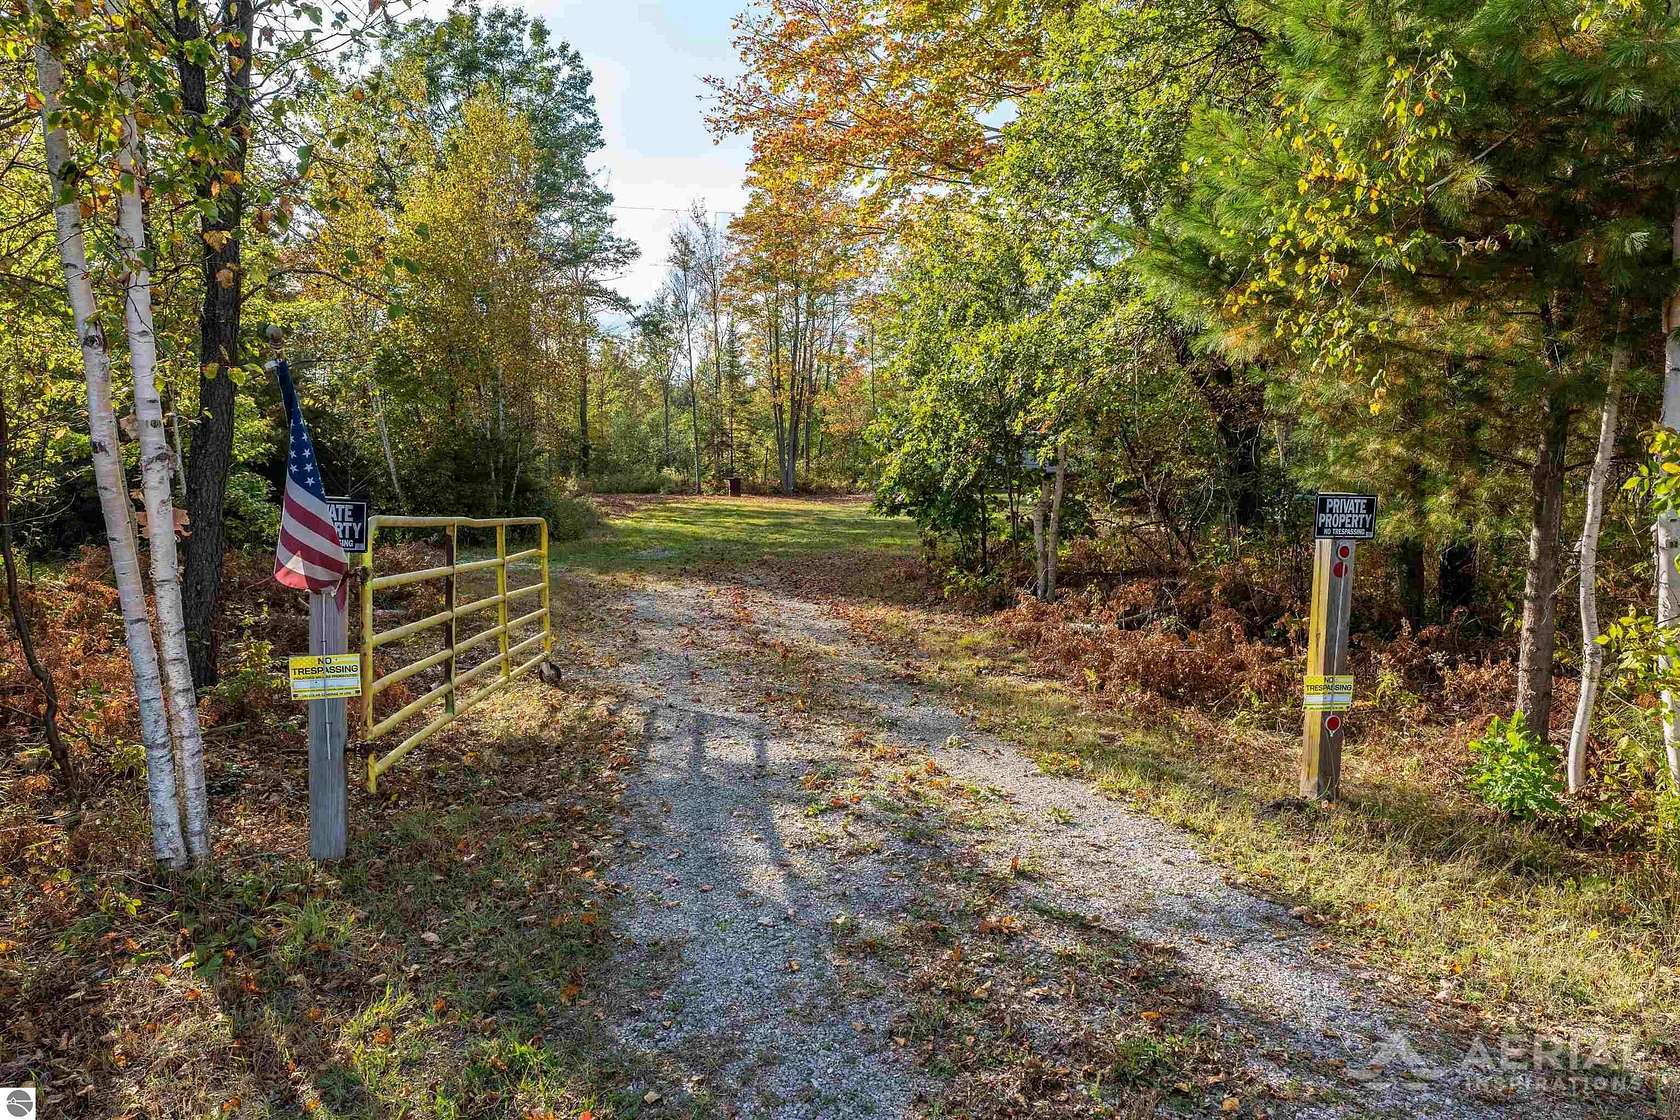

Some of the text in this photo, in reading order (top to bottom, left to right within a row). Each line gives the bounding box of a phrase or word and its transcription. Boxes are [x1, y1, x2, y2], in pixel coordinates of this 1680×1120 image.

[1326, 498, 1367, 513] PRIVATE
[1318, 513, 1372, 528] PROPERTY
[1332, 528, 1366, 536] TRESPASSING
[317, 657, 332, 665] NO
[292, 664, 359, 676] TRESPASSING
[1323, 676, 1334, 684] NO
